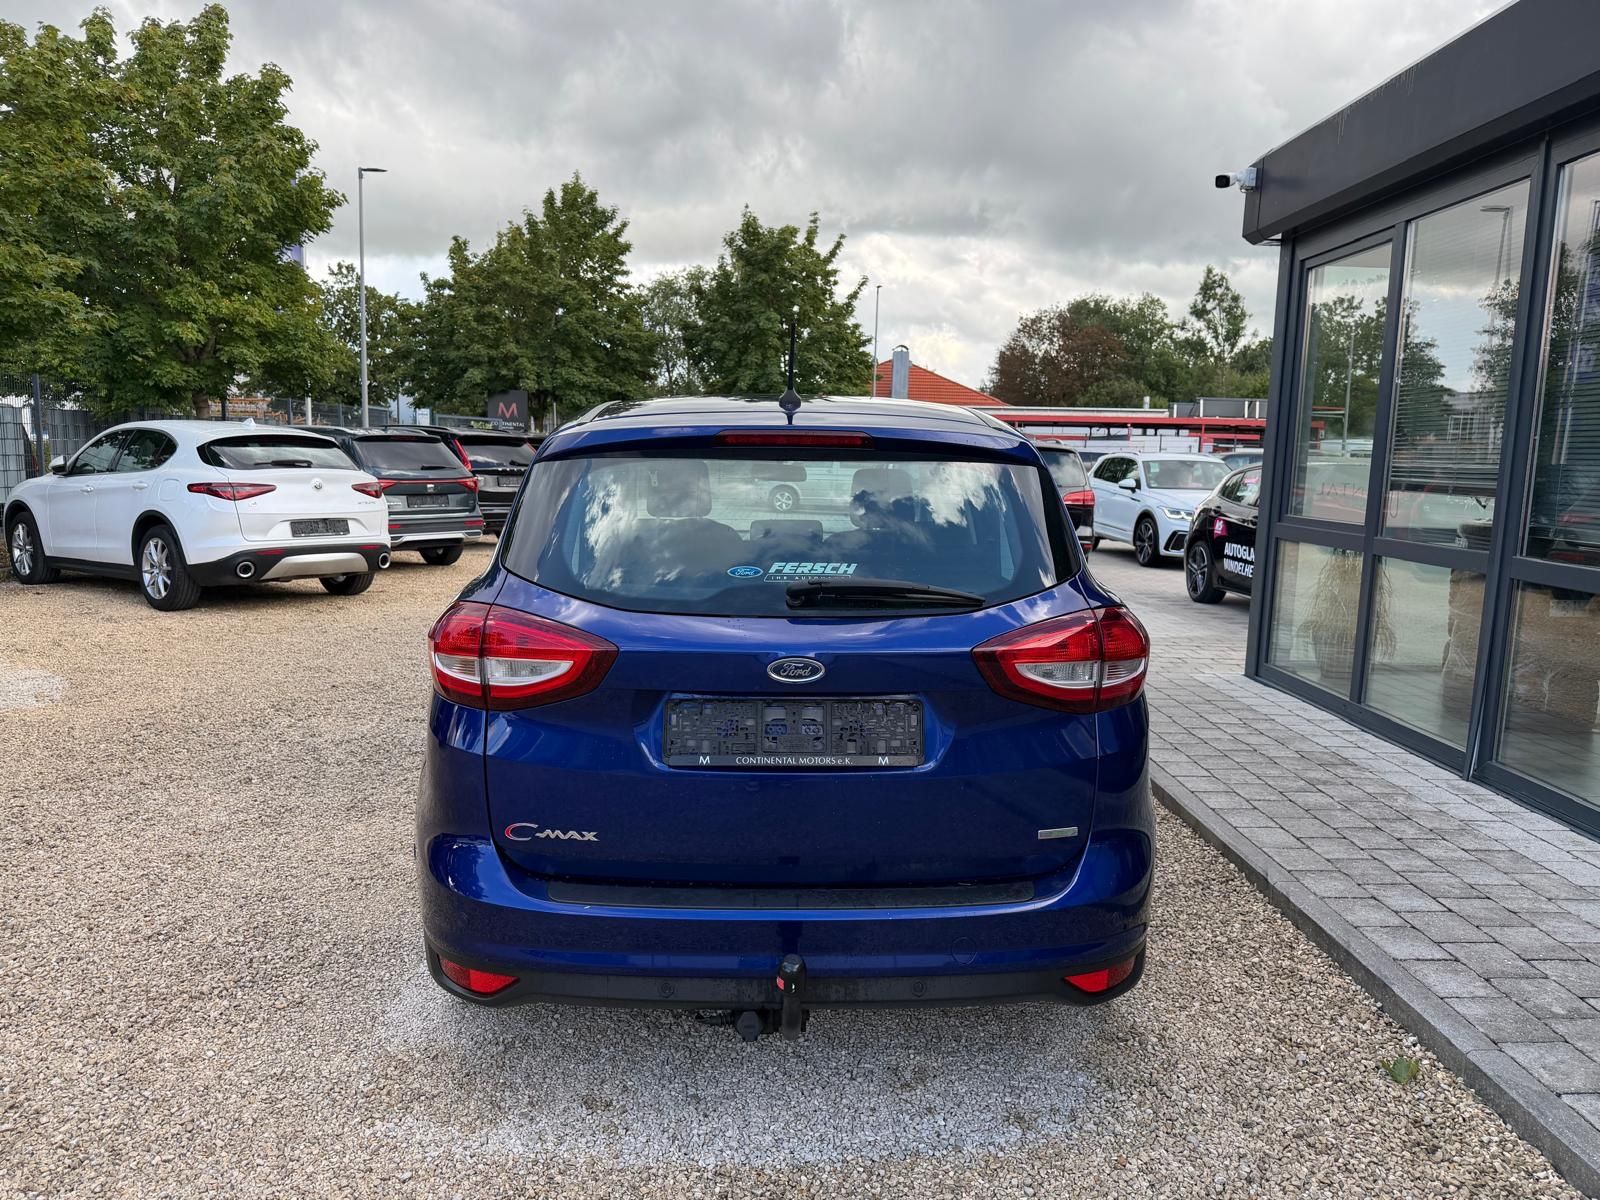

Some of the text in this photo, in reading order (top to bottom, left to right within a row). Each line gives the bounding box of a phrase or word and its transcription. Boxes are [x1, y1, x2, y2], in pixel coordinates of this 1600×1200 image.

[498, 402, 519, 419] M
[768, 562, 857, 574] FERSCH
[779, 662, 813, 677] Ford
[698, 756, 711, 765] M
[735, 756, 797, 765] CONTINENTAL
[799, 756, 836, 765] MOTORS
[877, 756, 890, 765] M
[504, 822, 600, 841] C-MAX
